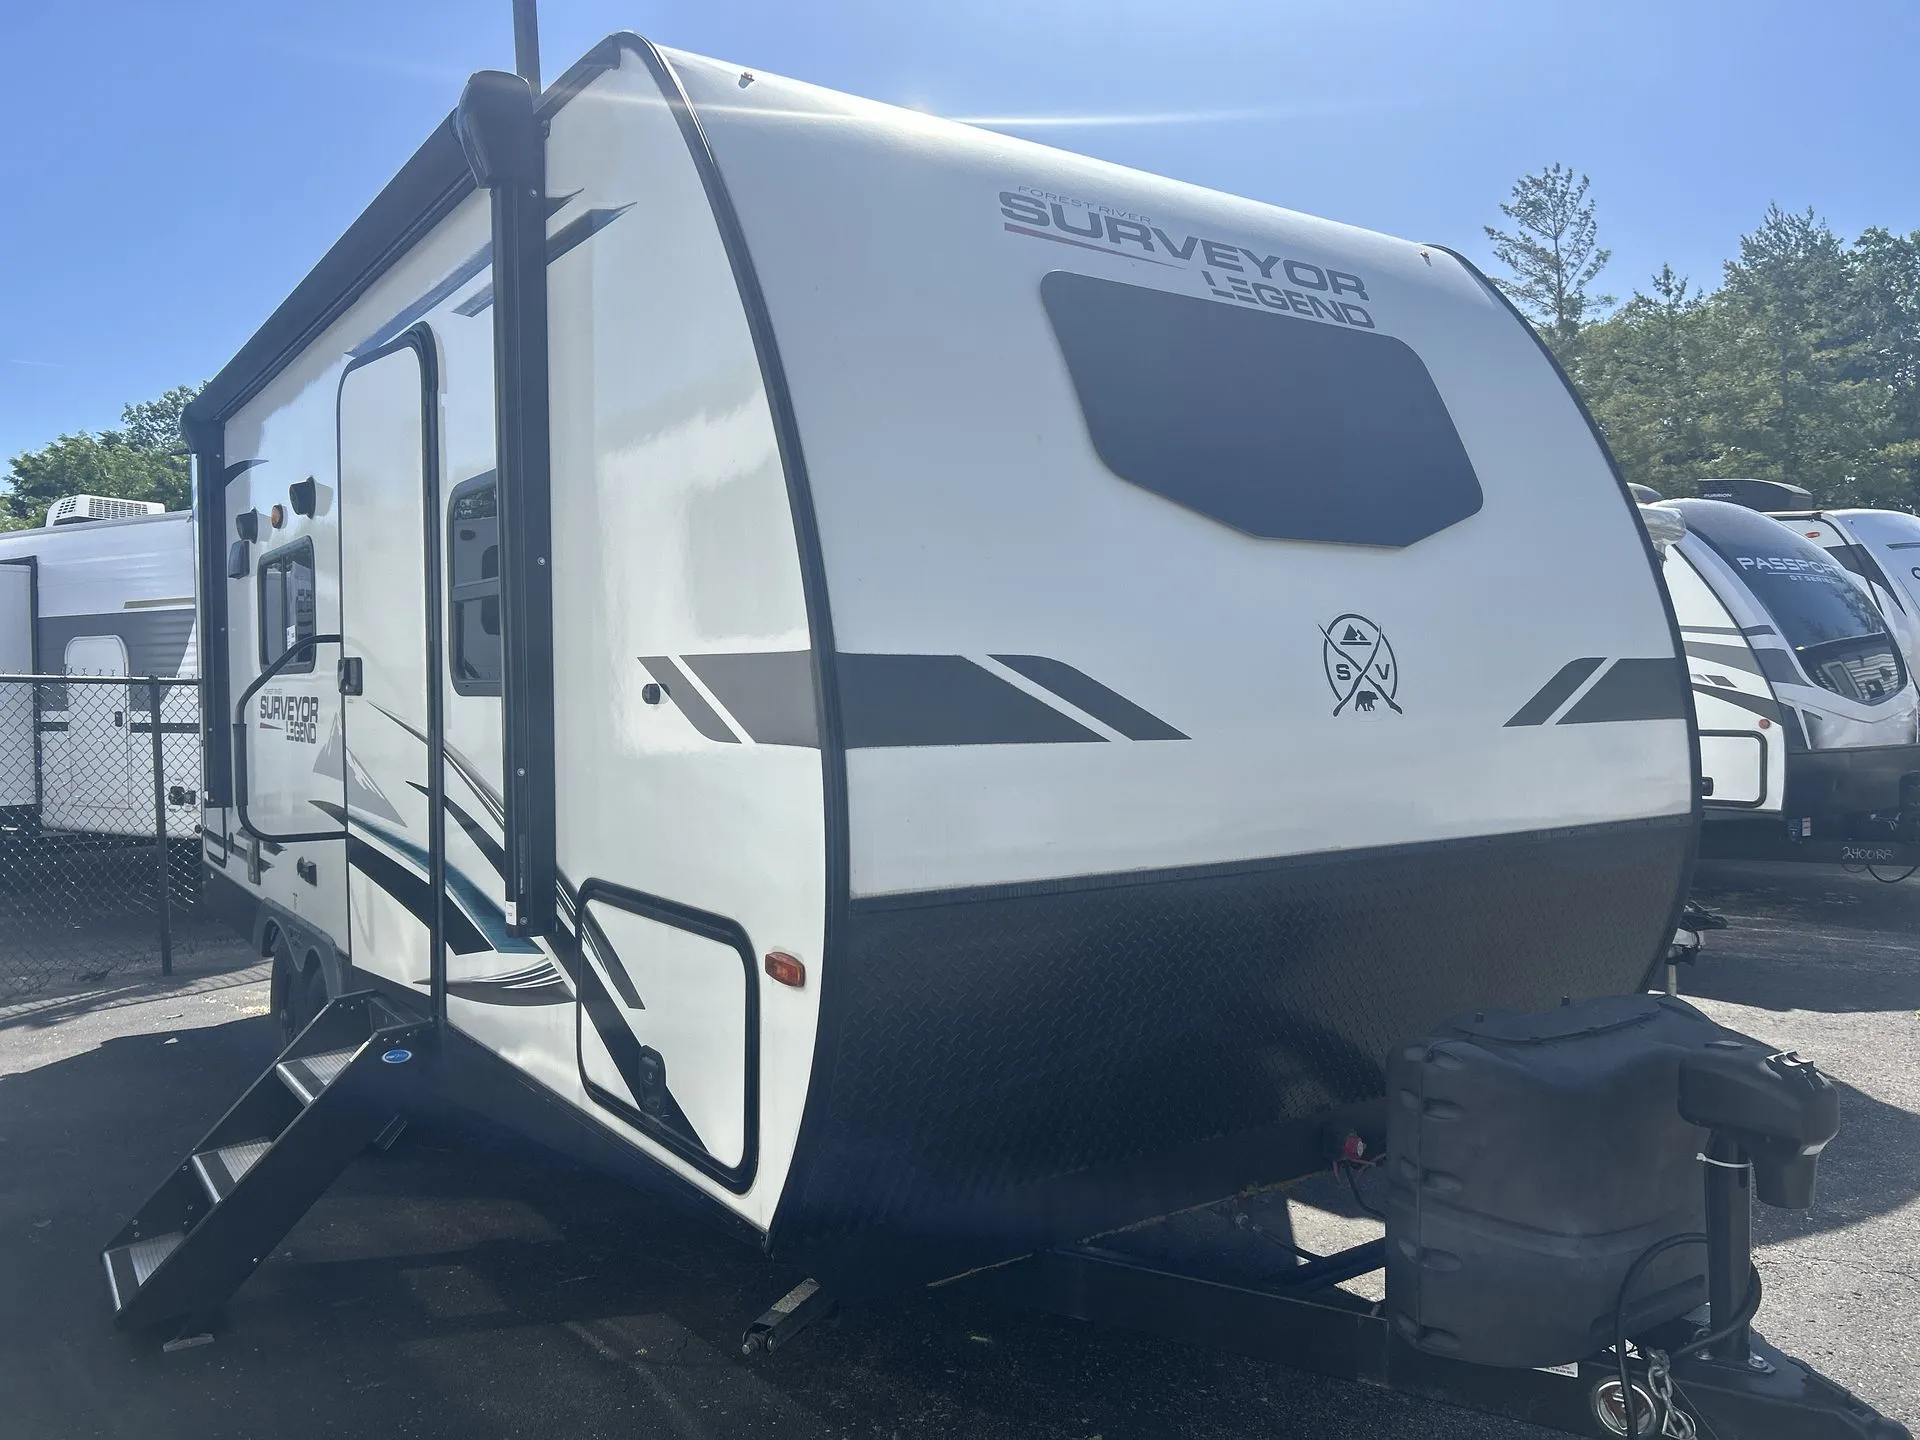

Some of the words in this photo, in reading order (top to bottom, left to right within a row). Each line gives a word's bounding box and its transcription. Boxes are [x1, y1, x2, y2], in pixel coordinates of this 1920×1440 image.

[1018, 185, 1094, 210] FOREST
[1098, 205, 1151, 223] RIVER
[999, 191, 1370, 301] SURVEYOR
[1201, 270, 1376, 330] LEGEND
[1336, 663, 1351, 681] S
[1374, 663, 1390, 681] V
[260, 695, 319, 723] SURVEYOR
[285, 721, 317, 744] LEGEND
